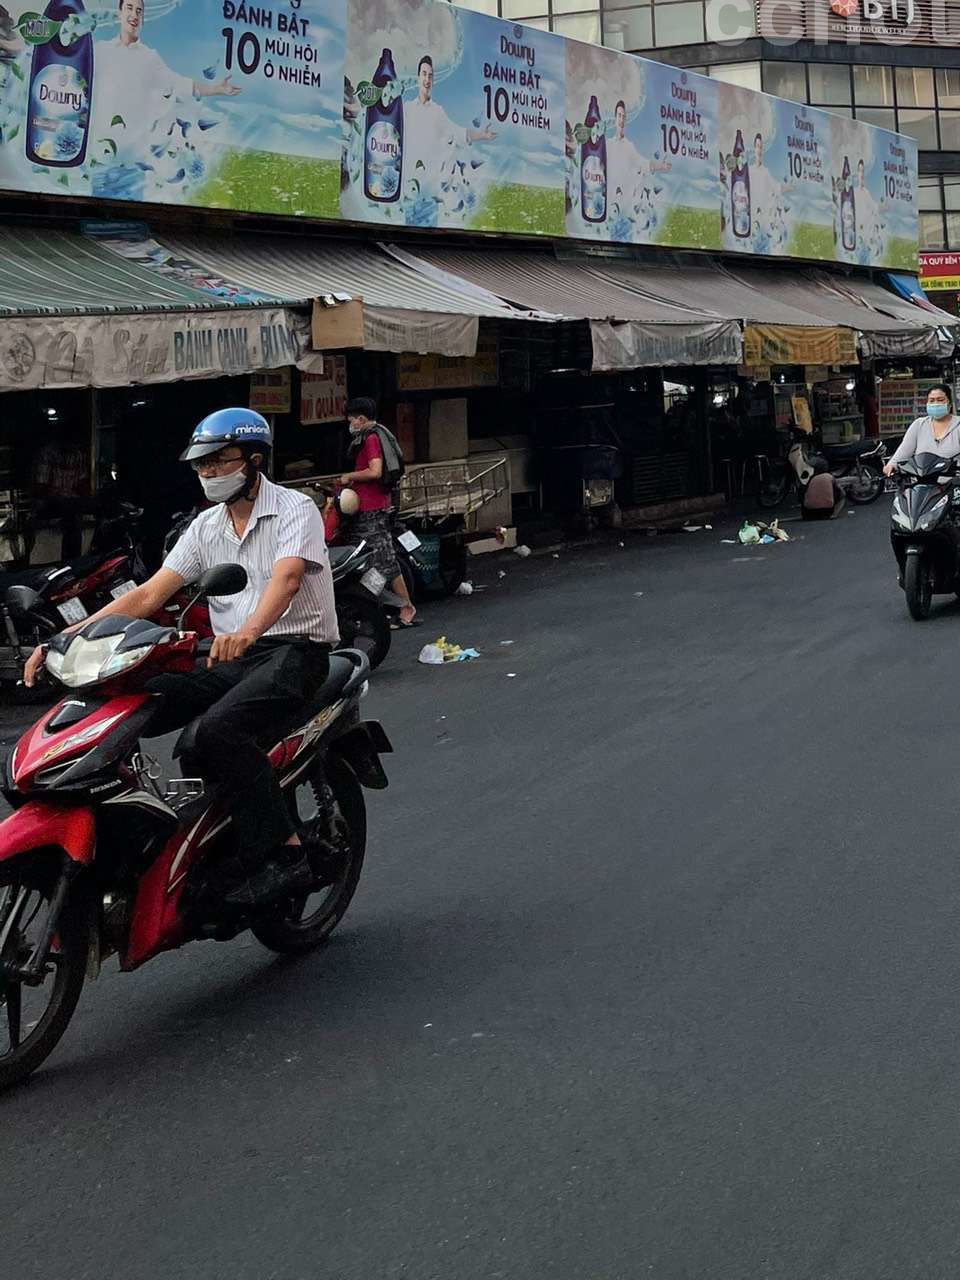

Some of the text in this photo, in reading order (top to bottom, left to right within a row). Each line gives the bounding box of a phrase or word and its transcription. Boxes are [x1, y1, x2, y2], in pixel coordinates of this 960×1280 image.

[222, 0, 310, 39] ĐÁNH BẬT
[222, 27, 261, 75] 10
[265, 37, 318, 64] MÙI HÔI
[500, 35, 535, 68] Downy
[264, 59, 274, 78] Ô
[483, 61, 541, 91] ĐÁNH BẬT
[39, 84, 83, 112] Downy
[483, 84, 510, 122] 10
[661, 123, 680, 155] 10
[788, 152, 802, 179] 10
